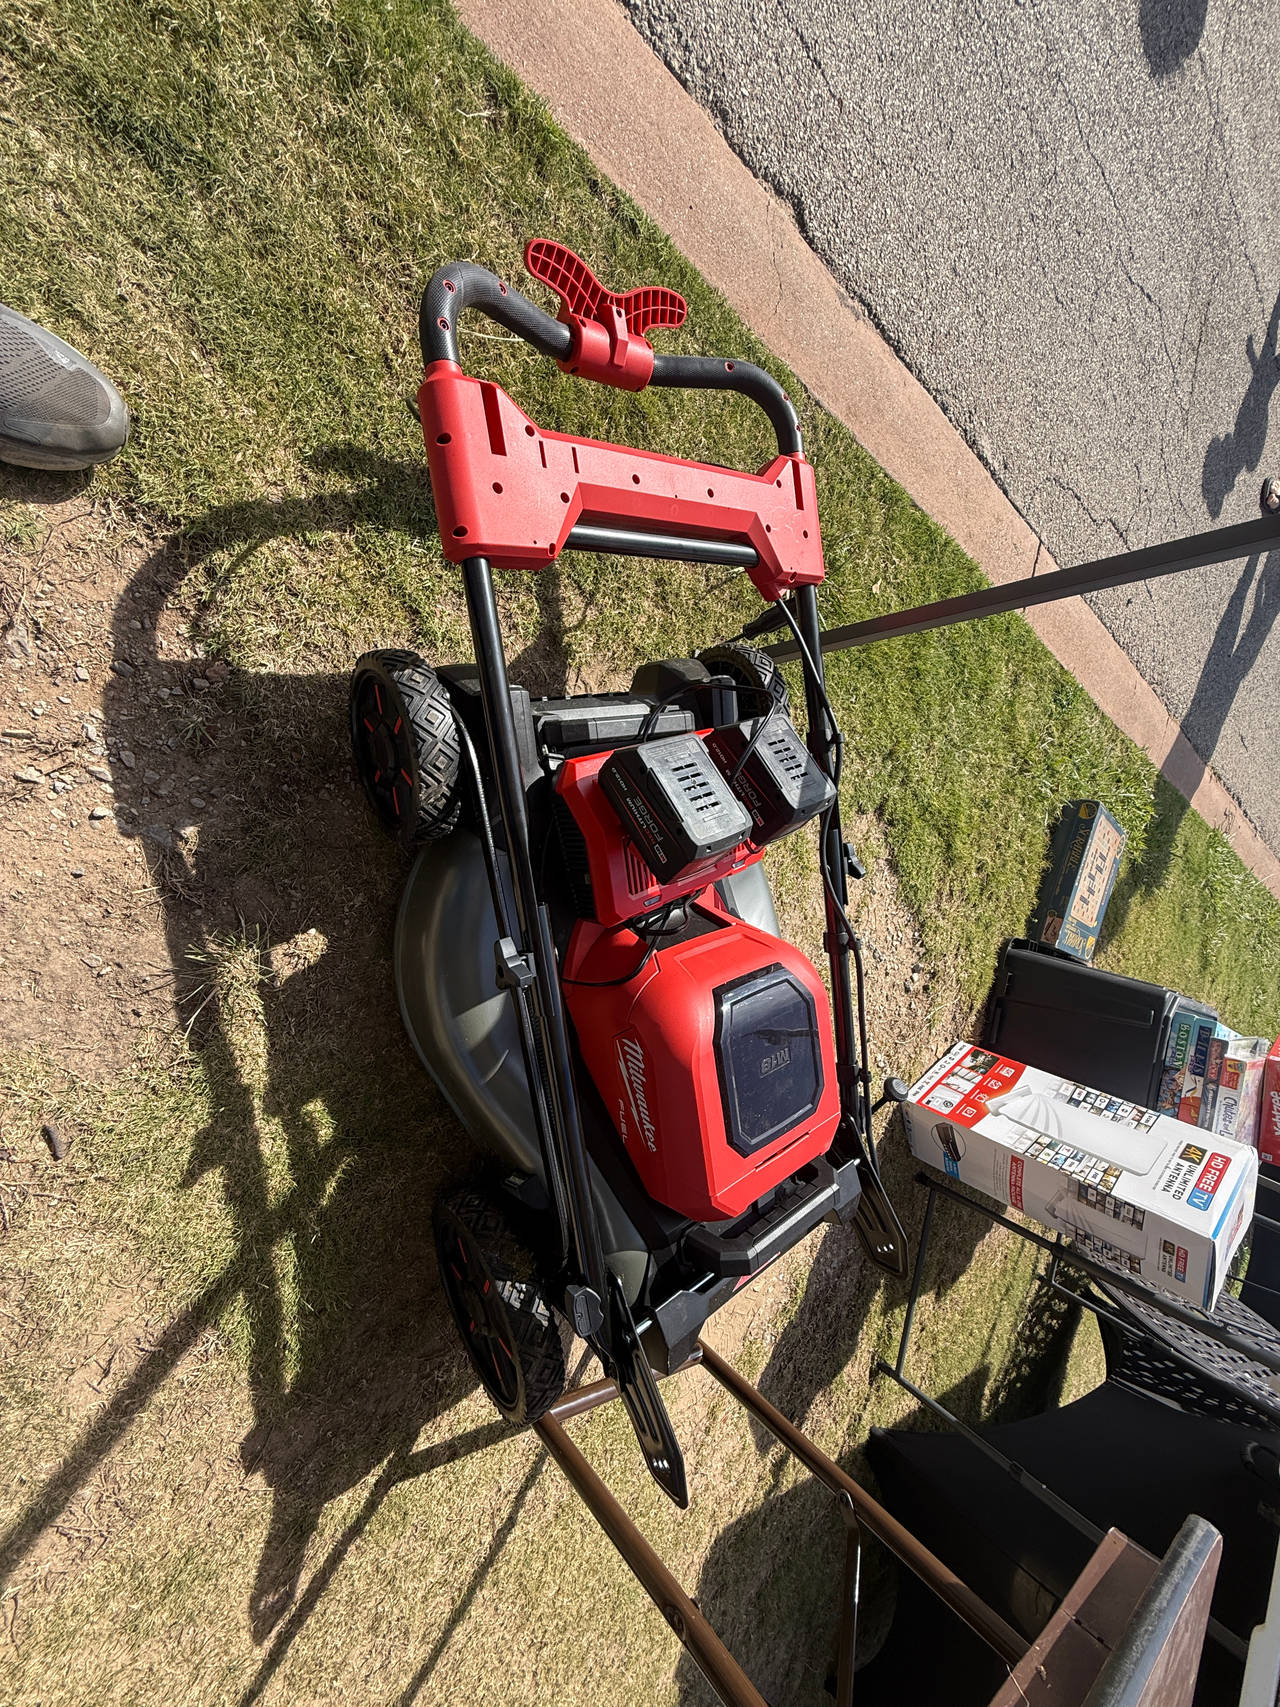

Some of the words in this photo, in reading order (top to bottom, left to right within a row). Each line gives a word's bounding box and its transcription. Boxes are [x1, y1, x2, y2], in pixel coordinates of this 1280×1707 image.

[633, 796, 664, 842] FORGE
[1173, 1023, 1191, 1070] BOSTON
[621, 1038, 657, 1152] Milwaukee
[1222, 1096, 1238, 1123] Chutes
[618, 1098, 628, 1144] FUEL
[1181, 1145, 1203, 1164] 4K
[1211, 1155, 1227, 1169] HD
[1161, 1162, 1185, 1193] ANTENNA
[1172, 1164, 1198, 1200] UNLIMITED
[1199, 1167, 1220, 1192] FREE
[1193, 1191, 1209, 1207] TV
